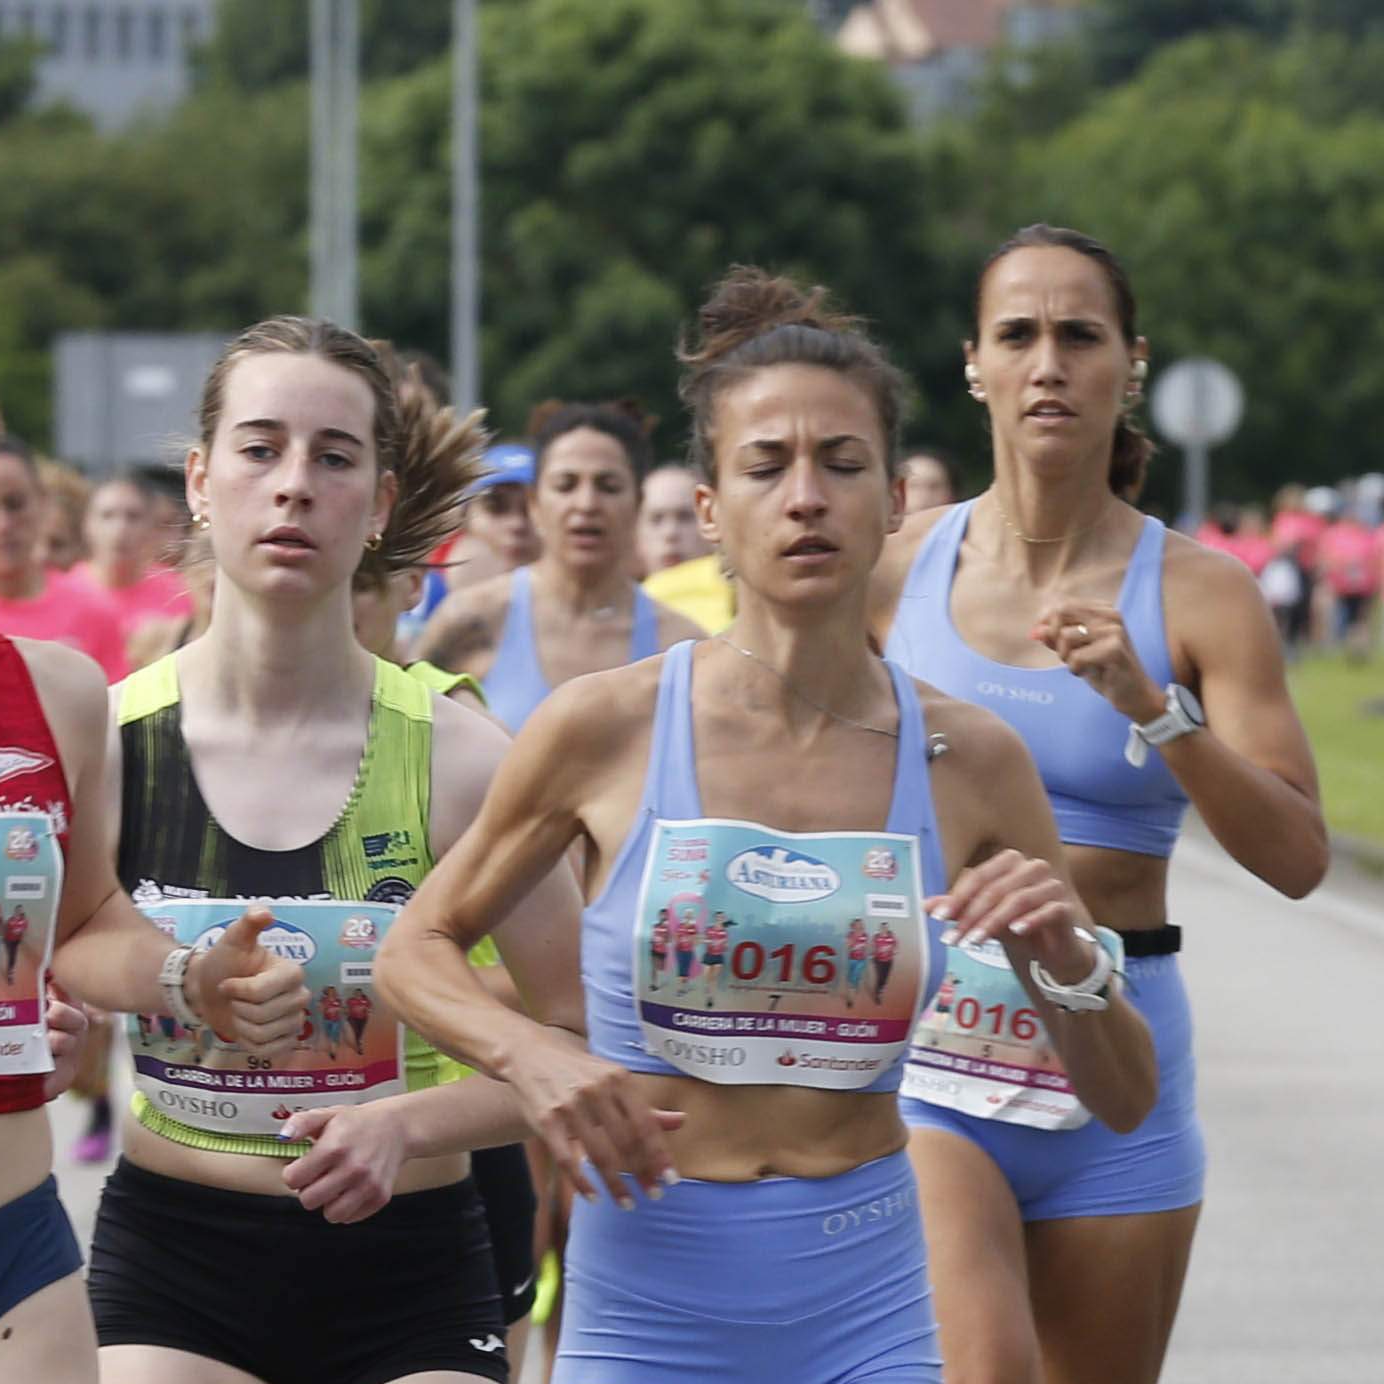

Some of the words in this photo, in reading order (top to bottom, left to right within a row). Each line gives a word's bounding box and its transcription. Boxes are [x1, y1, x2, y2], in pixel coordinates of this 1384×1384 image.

[731, 941, 837, 984] 016
[768, 994, 782, 1010] 7
[955, 997, 1040, 1041] 016
[165, 1067, 222, 1086] CARRERA
[226, 1074, 244, 1087] DE
[246, 1076, 265, 1088] LA
[159, 1089, 238, 1119] OYSHO
